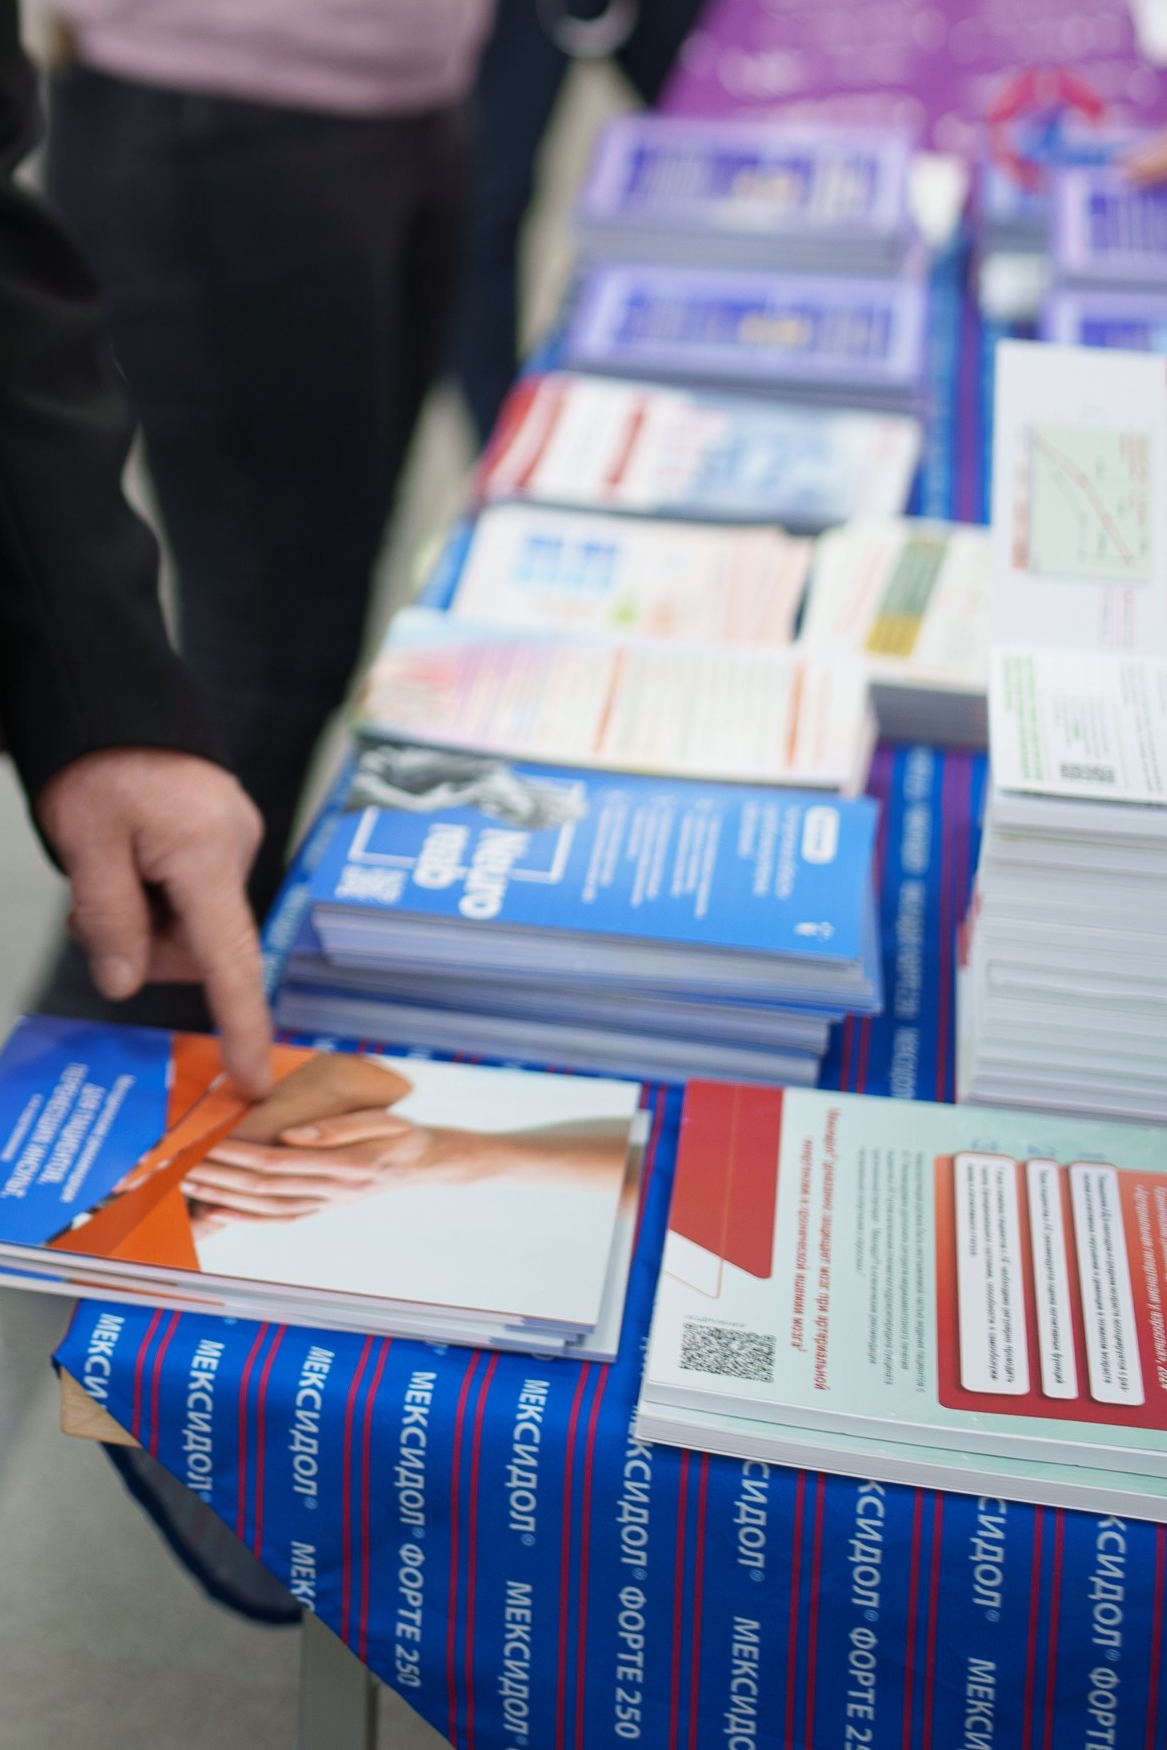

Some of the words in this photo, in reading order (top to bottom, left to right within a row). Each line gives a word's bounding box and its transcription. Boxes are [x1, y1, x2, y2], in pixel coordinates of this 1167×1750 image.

[793, 1273, 807, 1314] ишемии
[815, 1293, 830, 1312] при
[819, 1266, 832, 1290] мозг
[83, 1312, 126, 1407] МЕКСИ
[813, 1315, 831, 1390] артериальной
[616, 1403, 653, 1580] КСИДОЛ®
[396, 1543, 425, 1642] ФОРТЕ
[616, 1586, 647, 1683] ФОРТЕ
[395, 1643, 421, 1687] 250
[723, 1616, 761, 1750] МЕКСИДО
[847, 1627, 878, 1720] ФОРТЕ
[614, 1687, 643, 1739] 250
